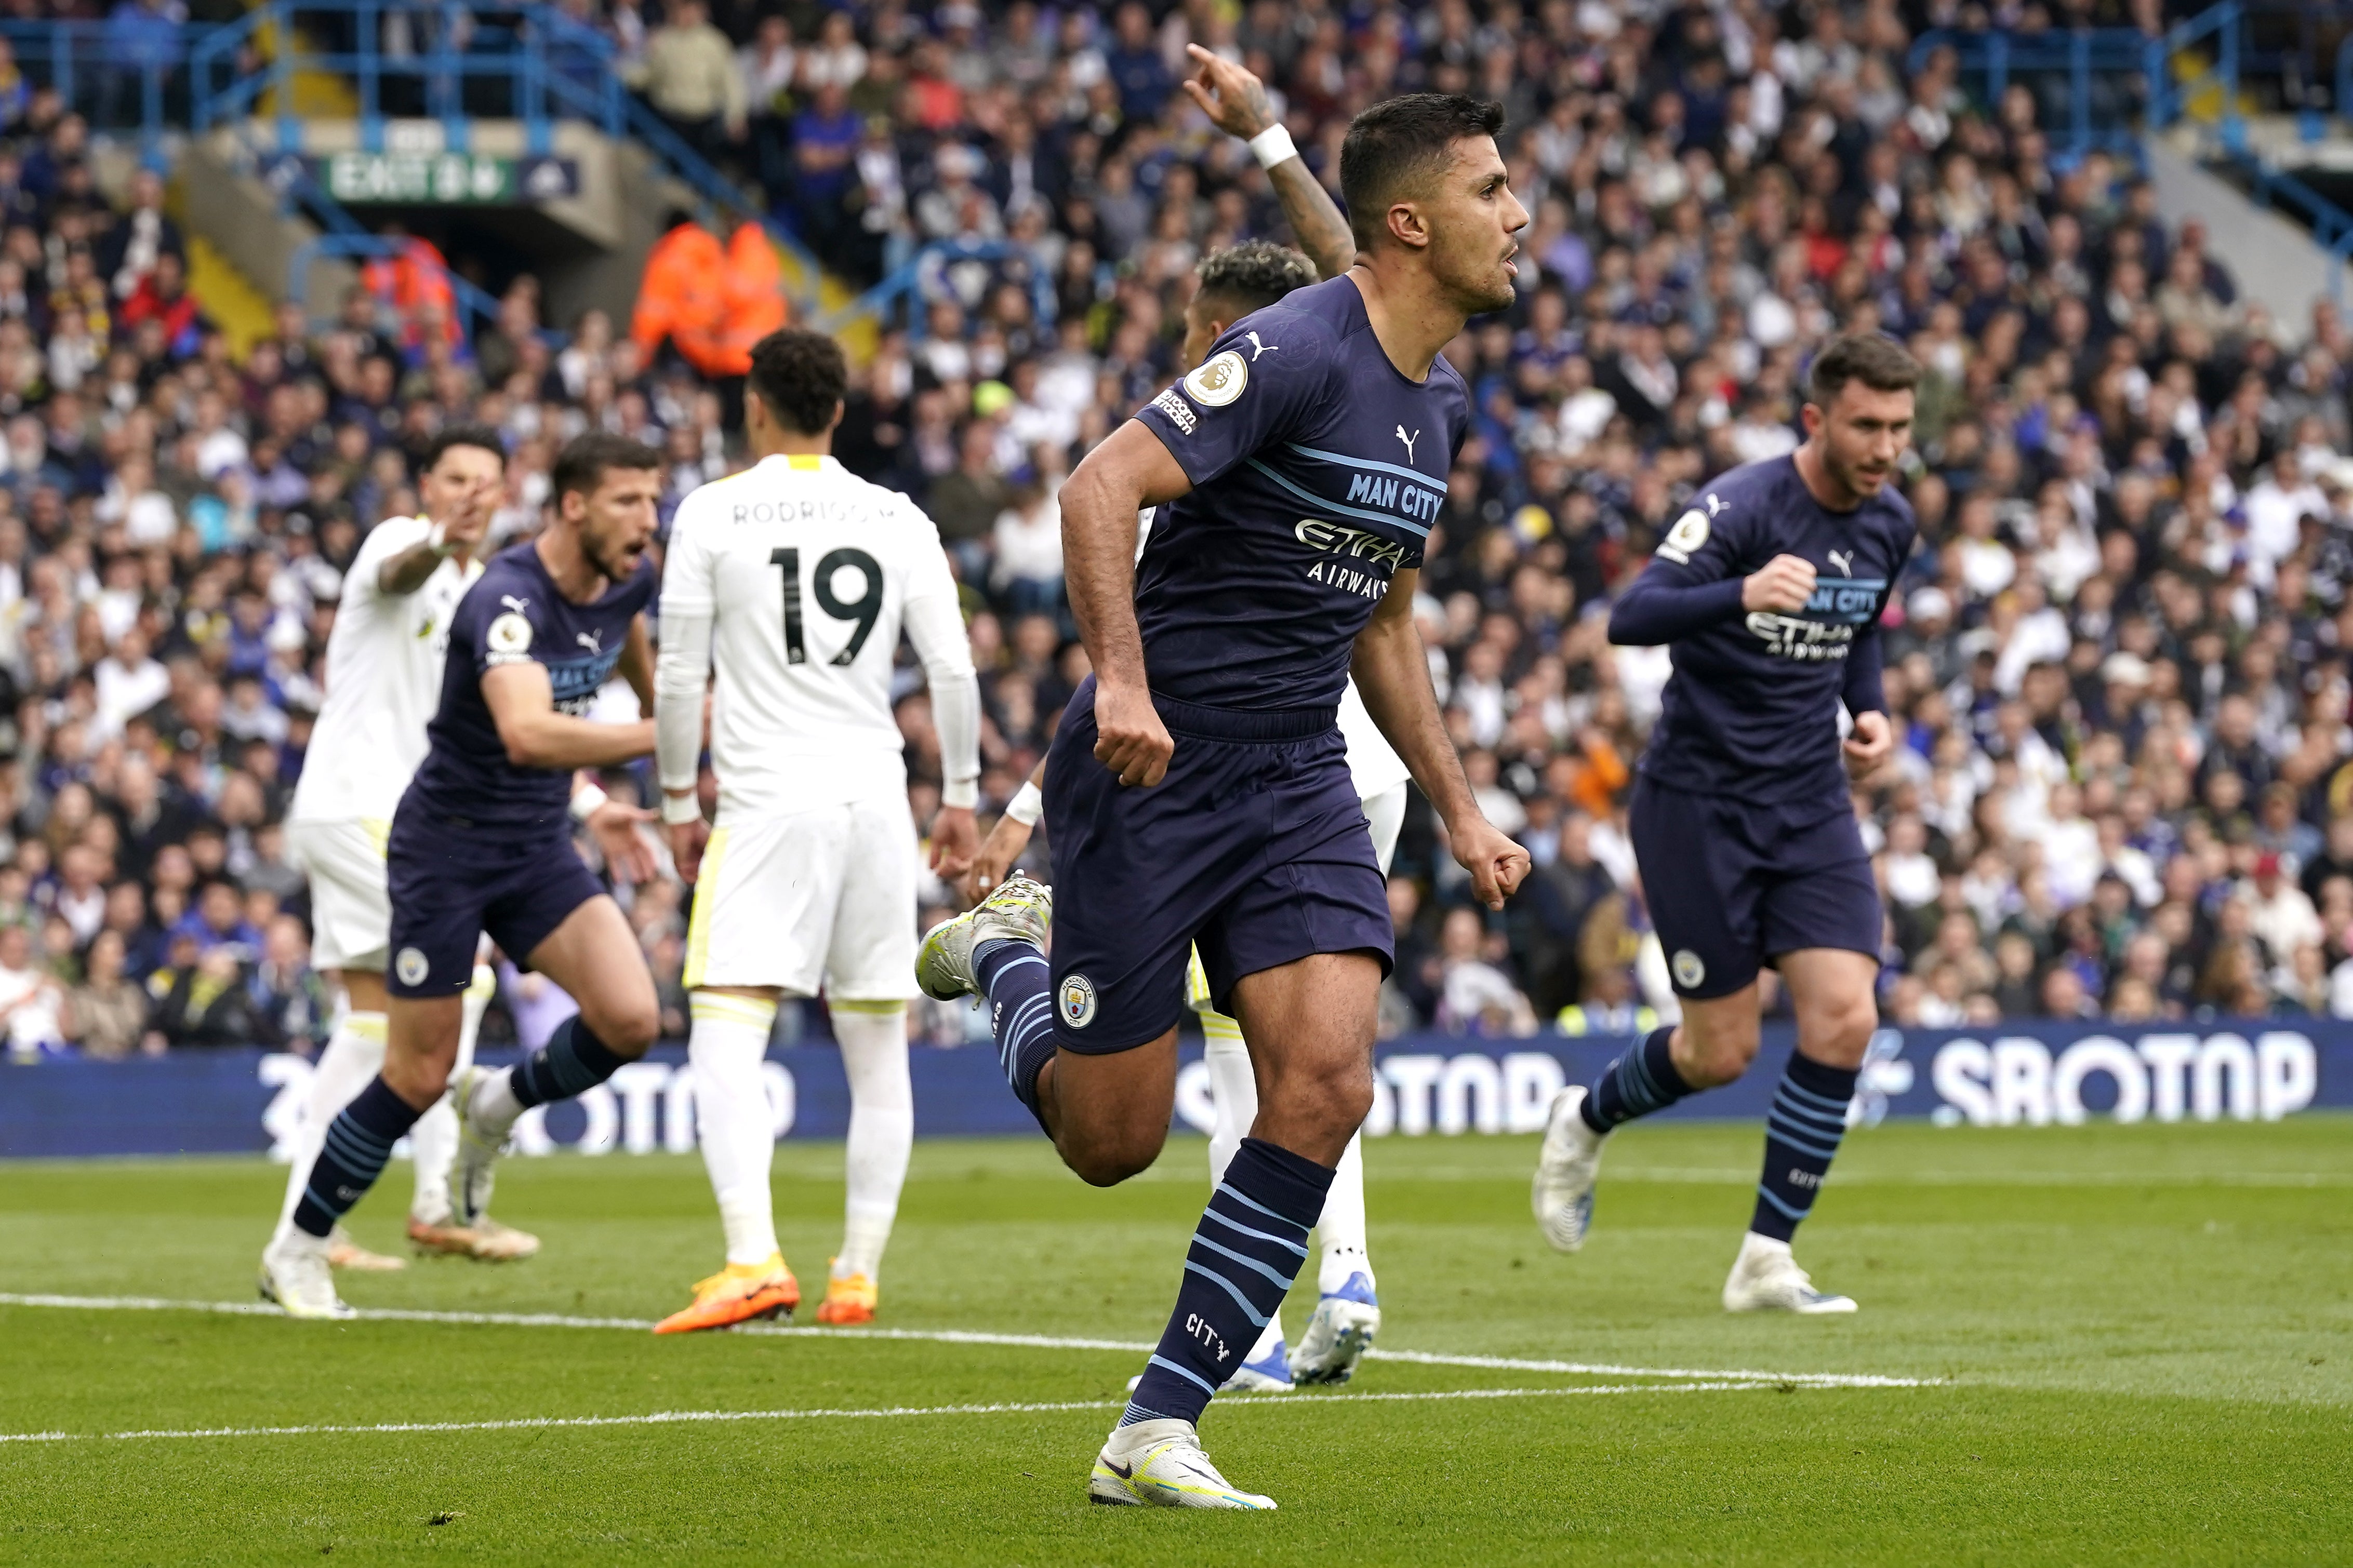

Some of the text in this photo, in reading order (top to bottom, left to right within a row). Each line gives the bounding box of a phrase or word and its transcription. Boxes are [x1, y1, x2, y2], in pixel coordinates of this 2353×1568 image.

[1159, 400, 1192, 435] racism
[1168, 395, 1197, 424] room
[1346, 474, 1443, 524] MAN CITY
[769, 546, 884, 666] 19
[1062, 977, 1092, 998] MANCHESTER
[1185, 1312, 1230, 1363] CITY
